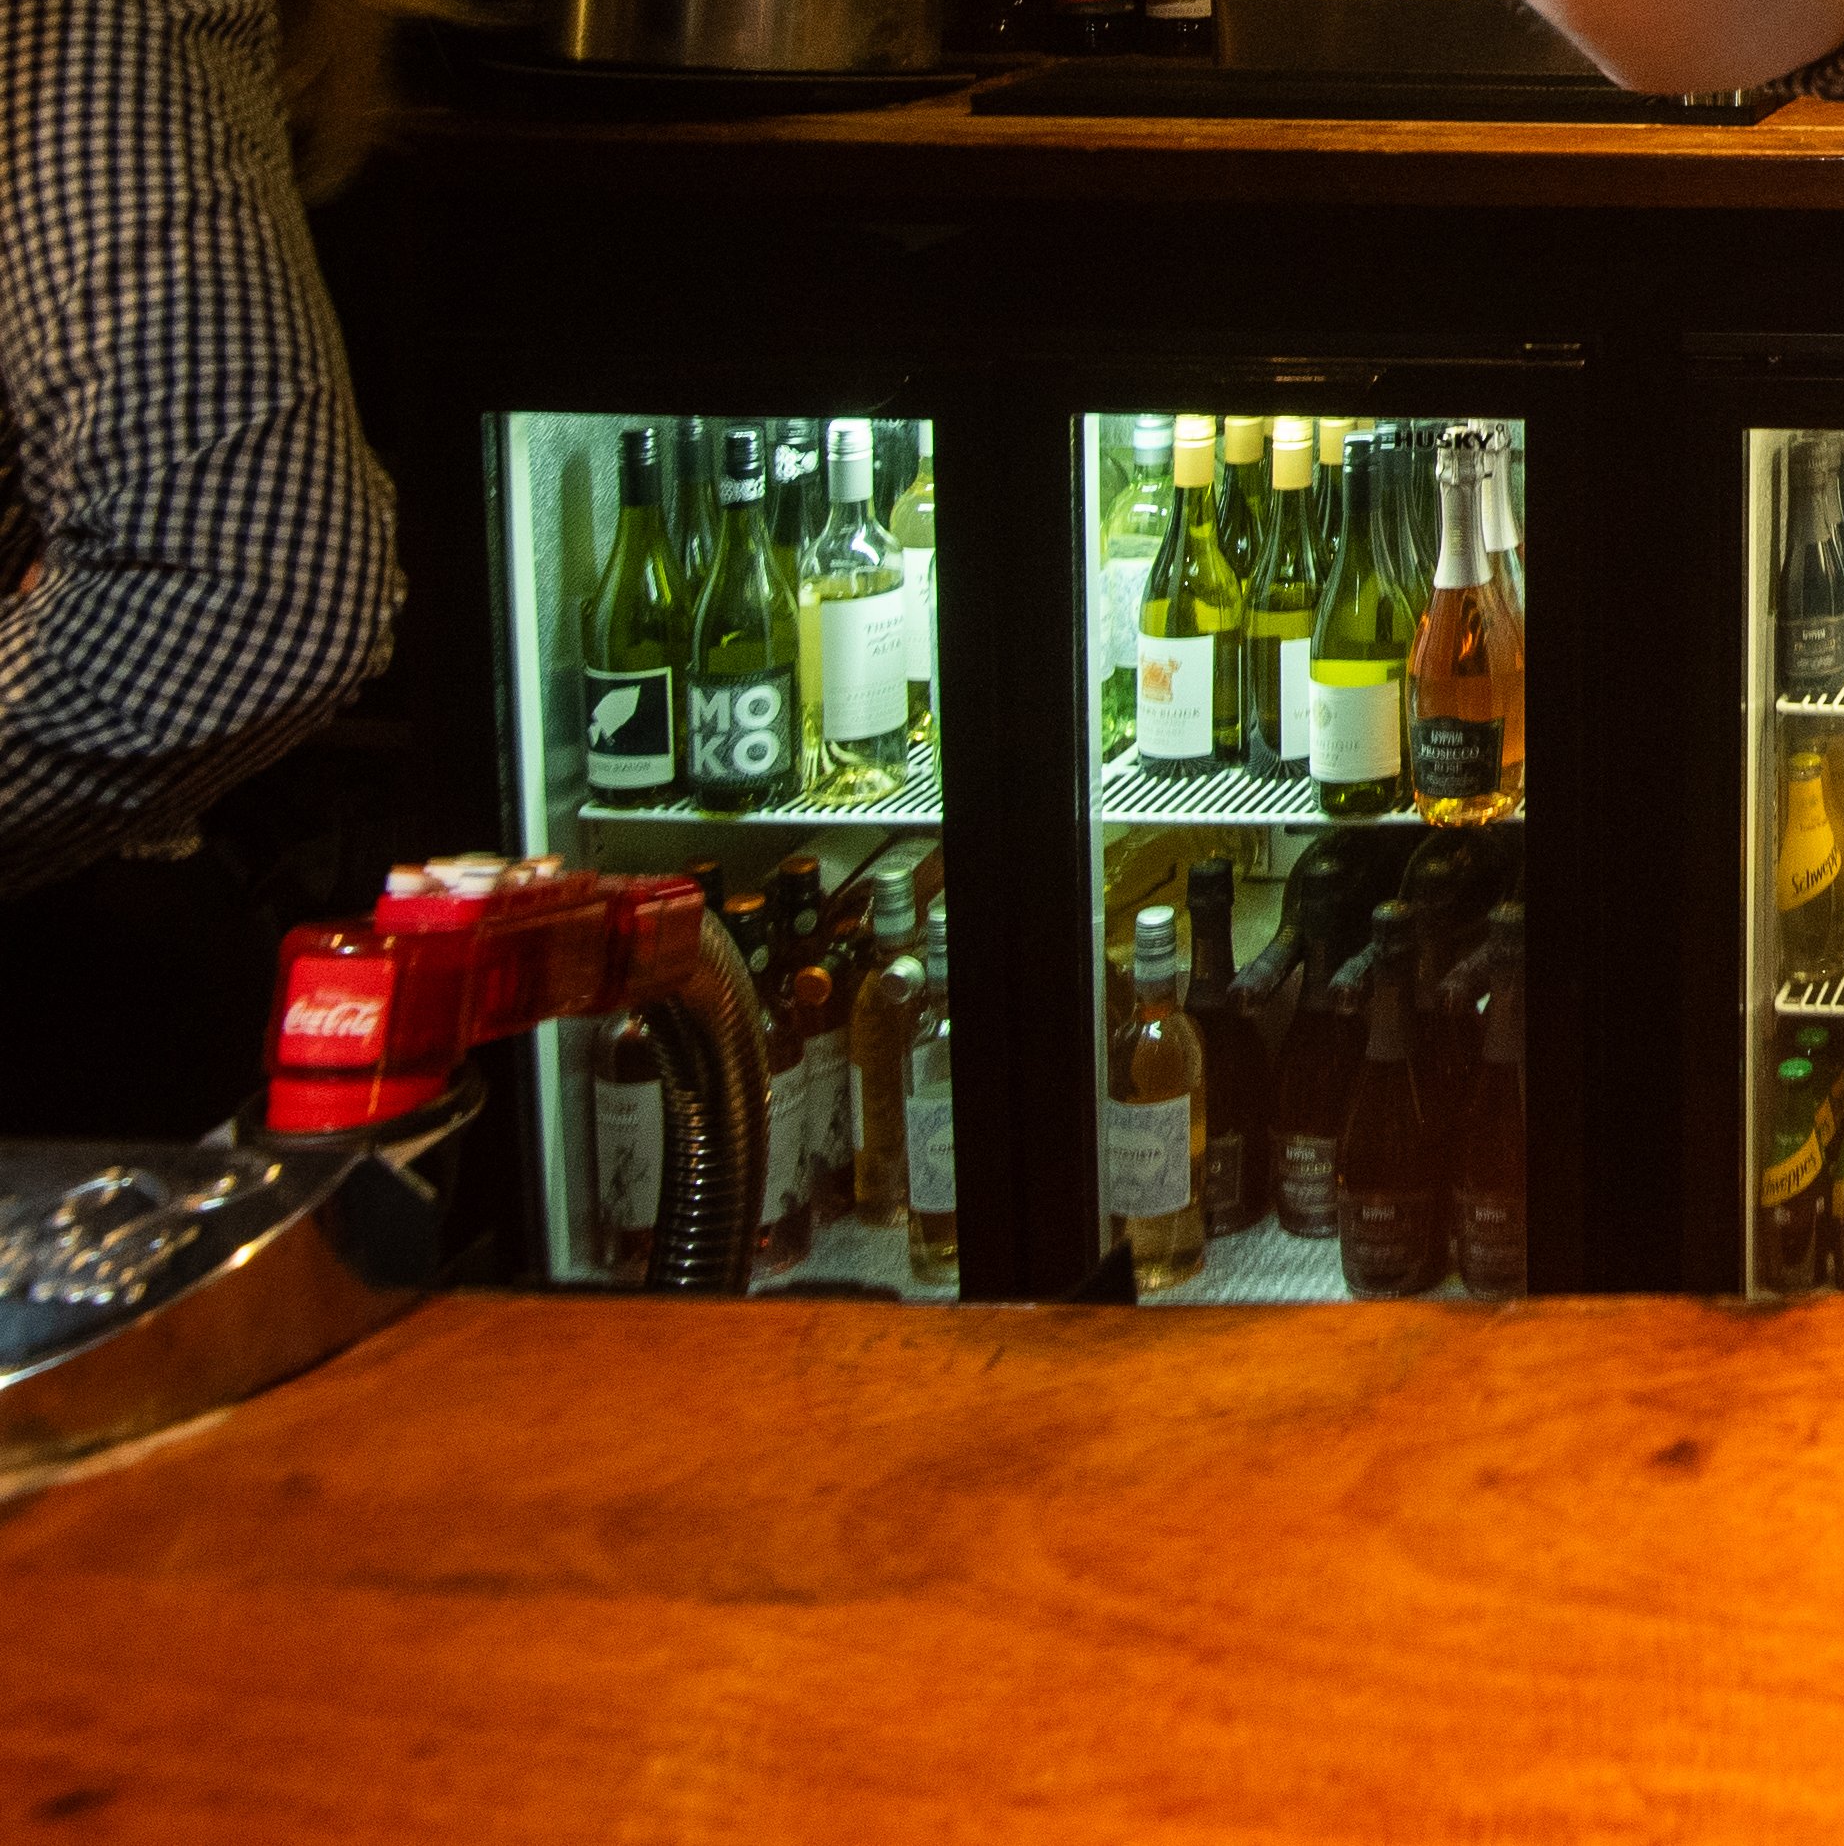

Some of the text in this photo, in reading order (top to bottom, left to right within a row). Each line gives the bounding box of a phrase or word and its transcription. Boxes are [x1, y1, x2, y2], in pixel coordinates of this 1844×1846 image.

[1394, 430, 1489, 450] HUSKY
[692, 684, 783, 731] MO
[692, 729, 781, 776] KO
[1419, 743, 1481, 761] PROSECCO
